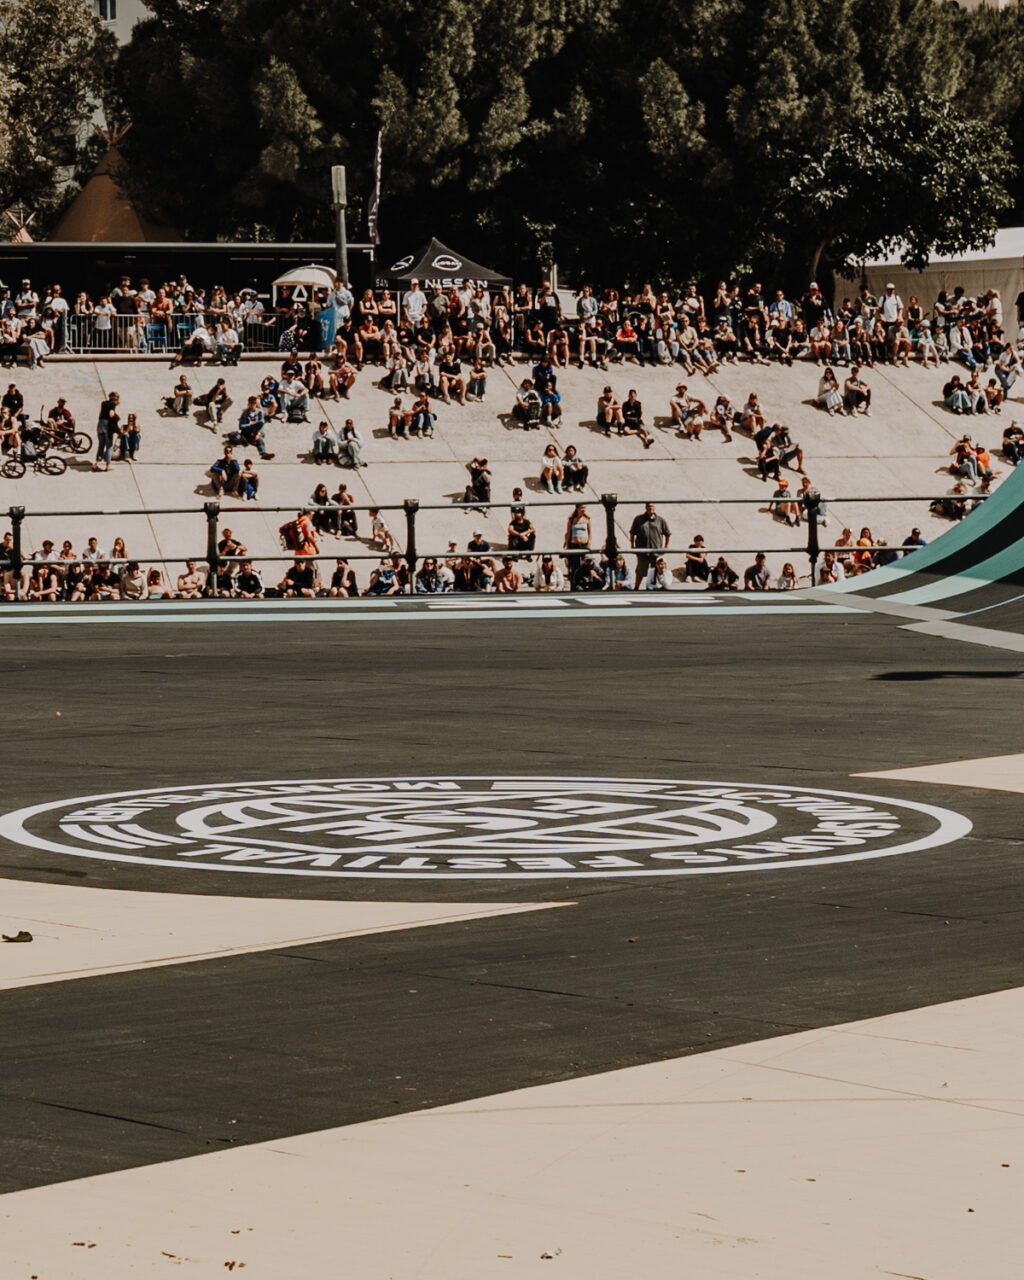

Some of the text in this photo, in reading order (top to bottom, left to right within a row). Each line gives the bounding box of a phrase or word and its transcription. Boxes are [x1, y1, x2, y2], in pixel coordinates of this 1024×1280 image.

[60, 781, 460, 822] MONTPELLIER
[281, 798, 658, 841] FISE
[176, 787, 902, 870] ACTION SPORTS FESTIVAL
